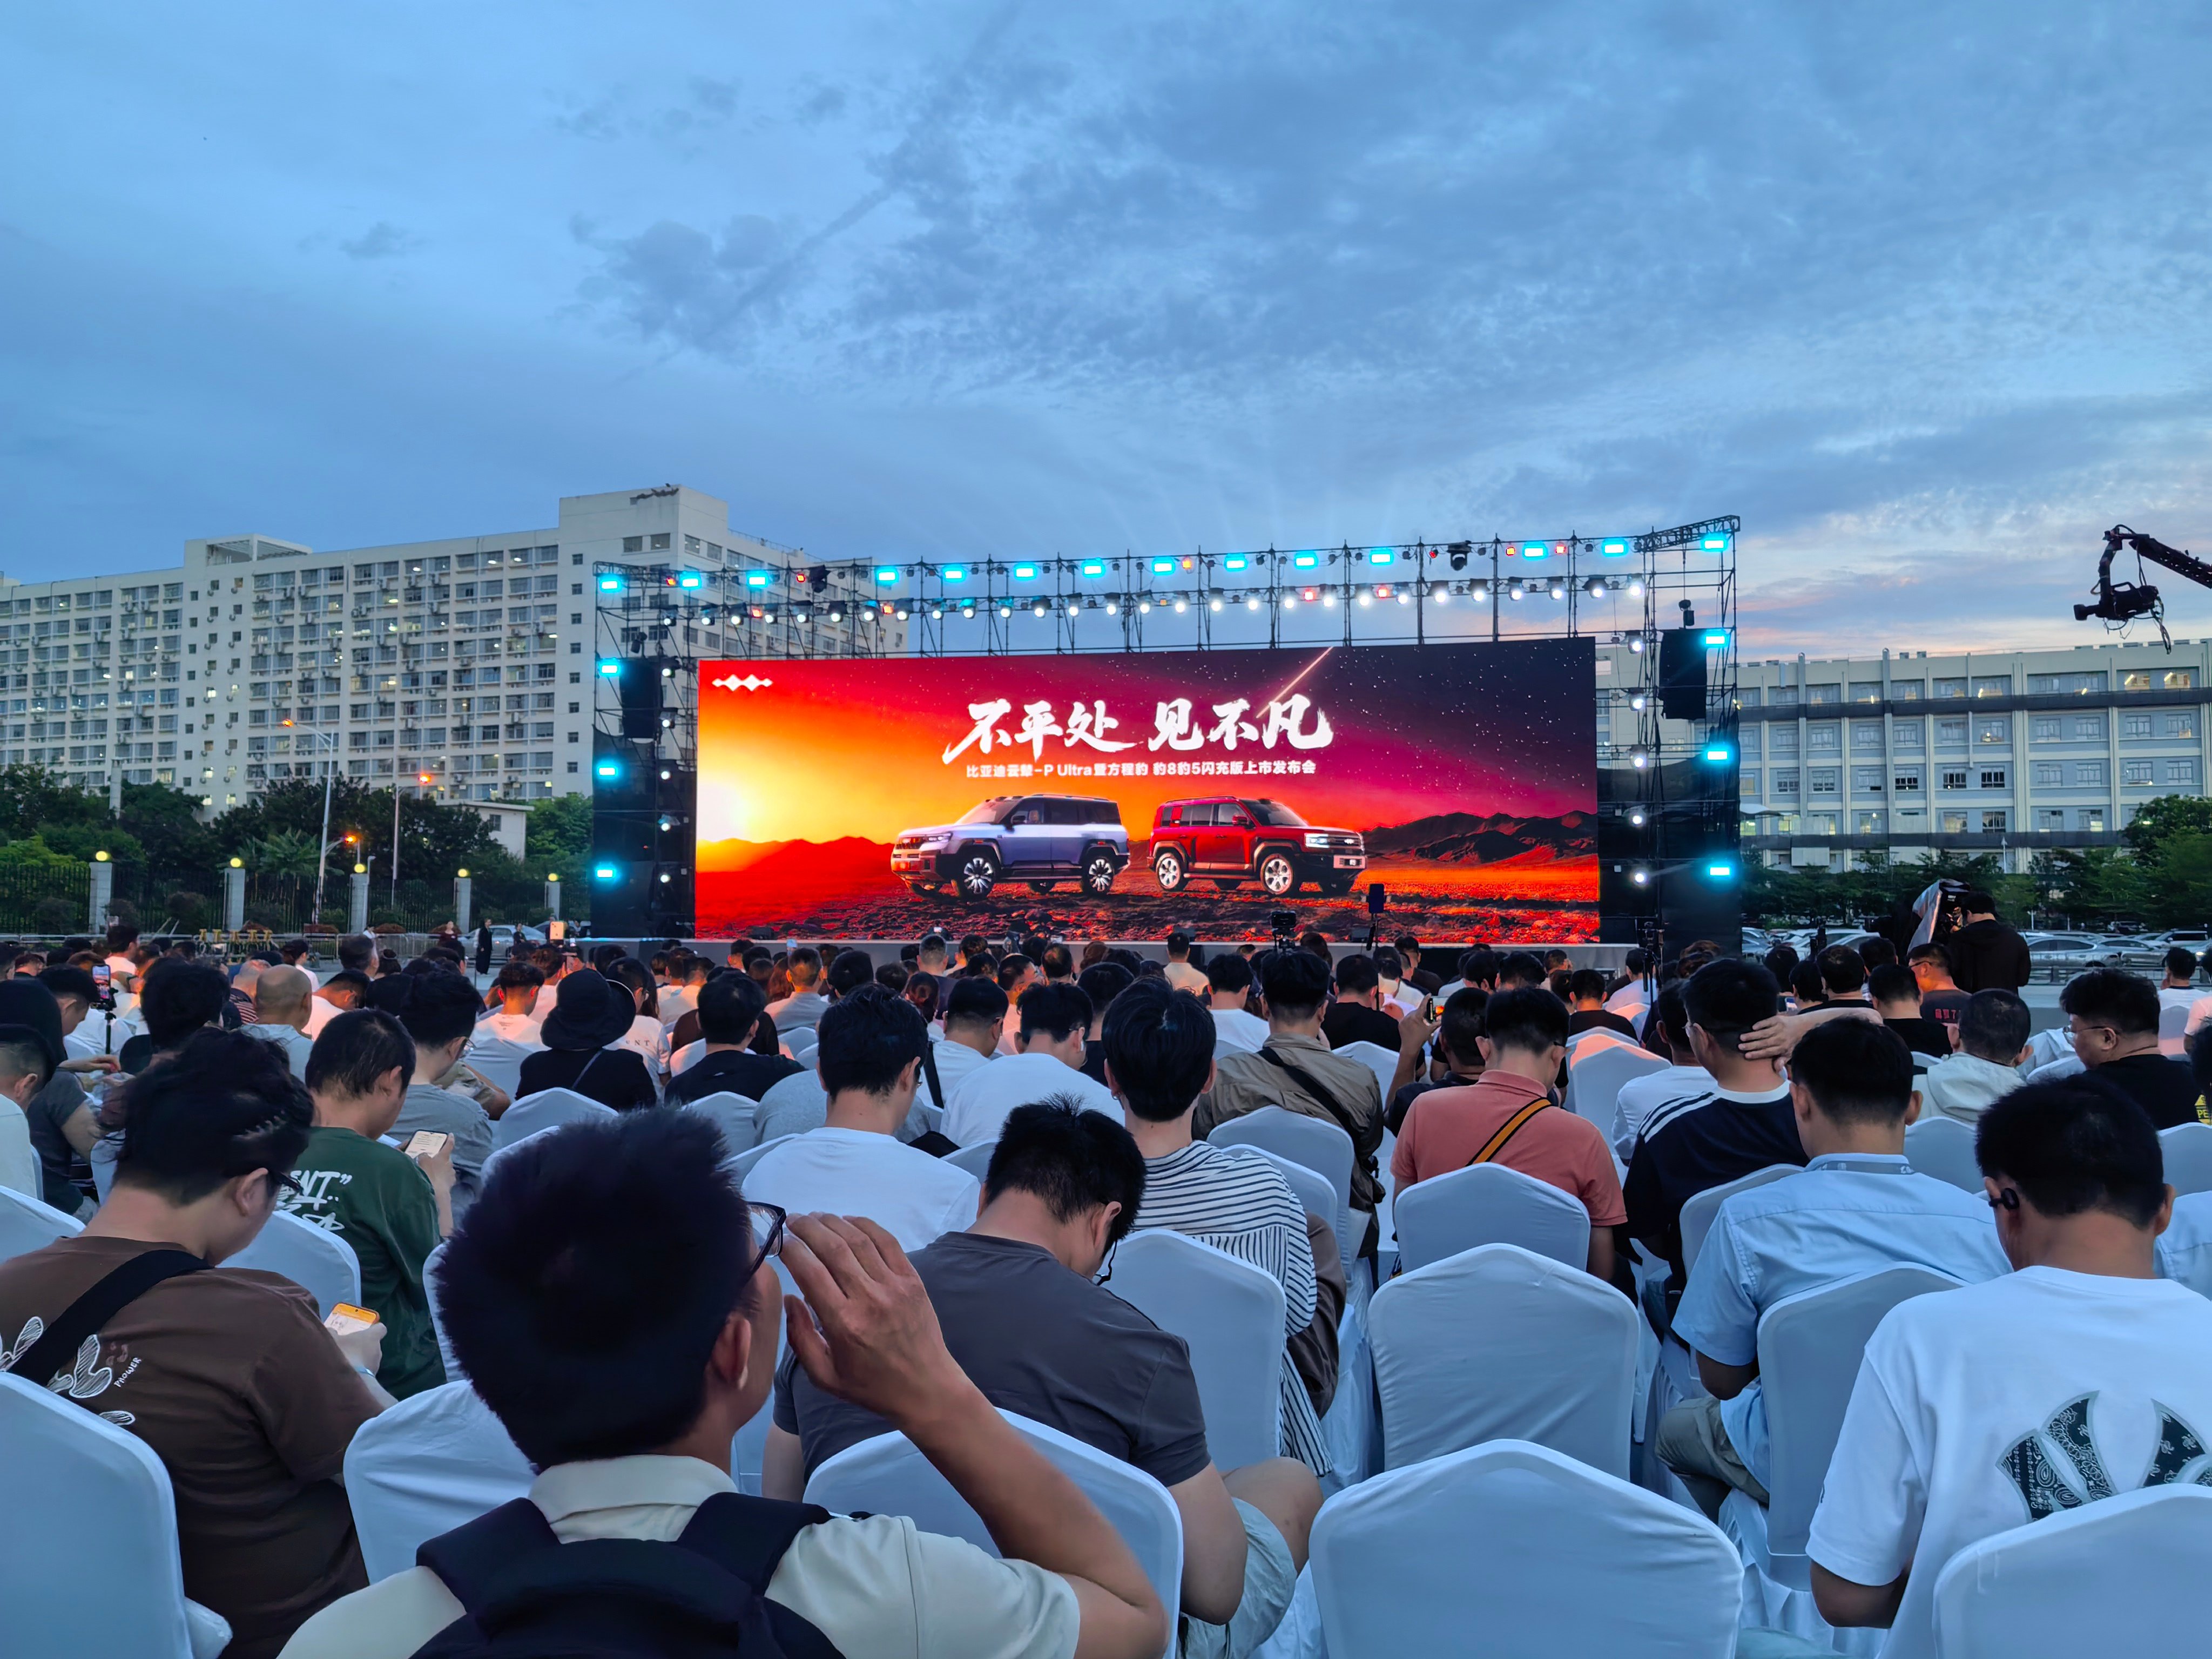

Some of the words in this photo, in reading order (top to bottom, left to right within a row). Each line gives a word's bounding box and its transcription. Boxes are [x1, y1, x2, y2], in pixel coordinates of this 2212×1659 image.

[942, 698, 1138, 764] 不平处
[1148, 693, 1334, 752] 见不凡
